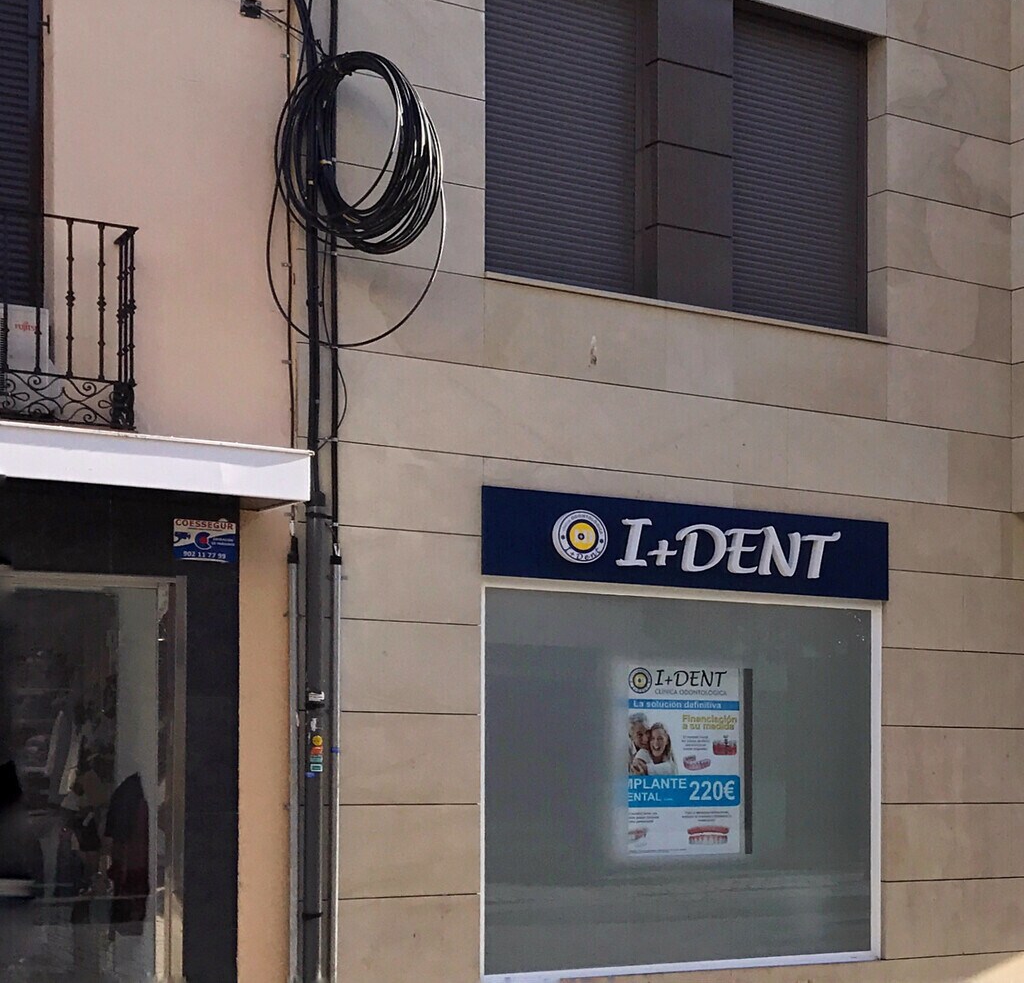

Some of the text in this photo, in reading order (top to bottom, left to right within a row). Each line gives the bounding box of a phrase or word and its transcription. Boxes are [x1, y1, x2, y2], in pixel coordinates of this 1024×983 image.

[175, 519, 233, 530] COESSEGUR
[616, 517, 842, 580] I+DENT
[654, 669, 728, 688] I+DENT
[633, 700, 644, 708] La
[683, 701, 722, 710] definitiva
[689, 780, 736, 801] 220€
